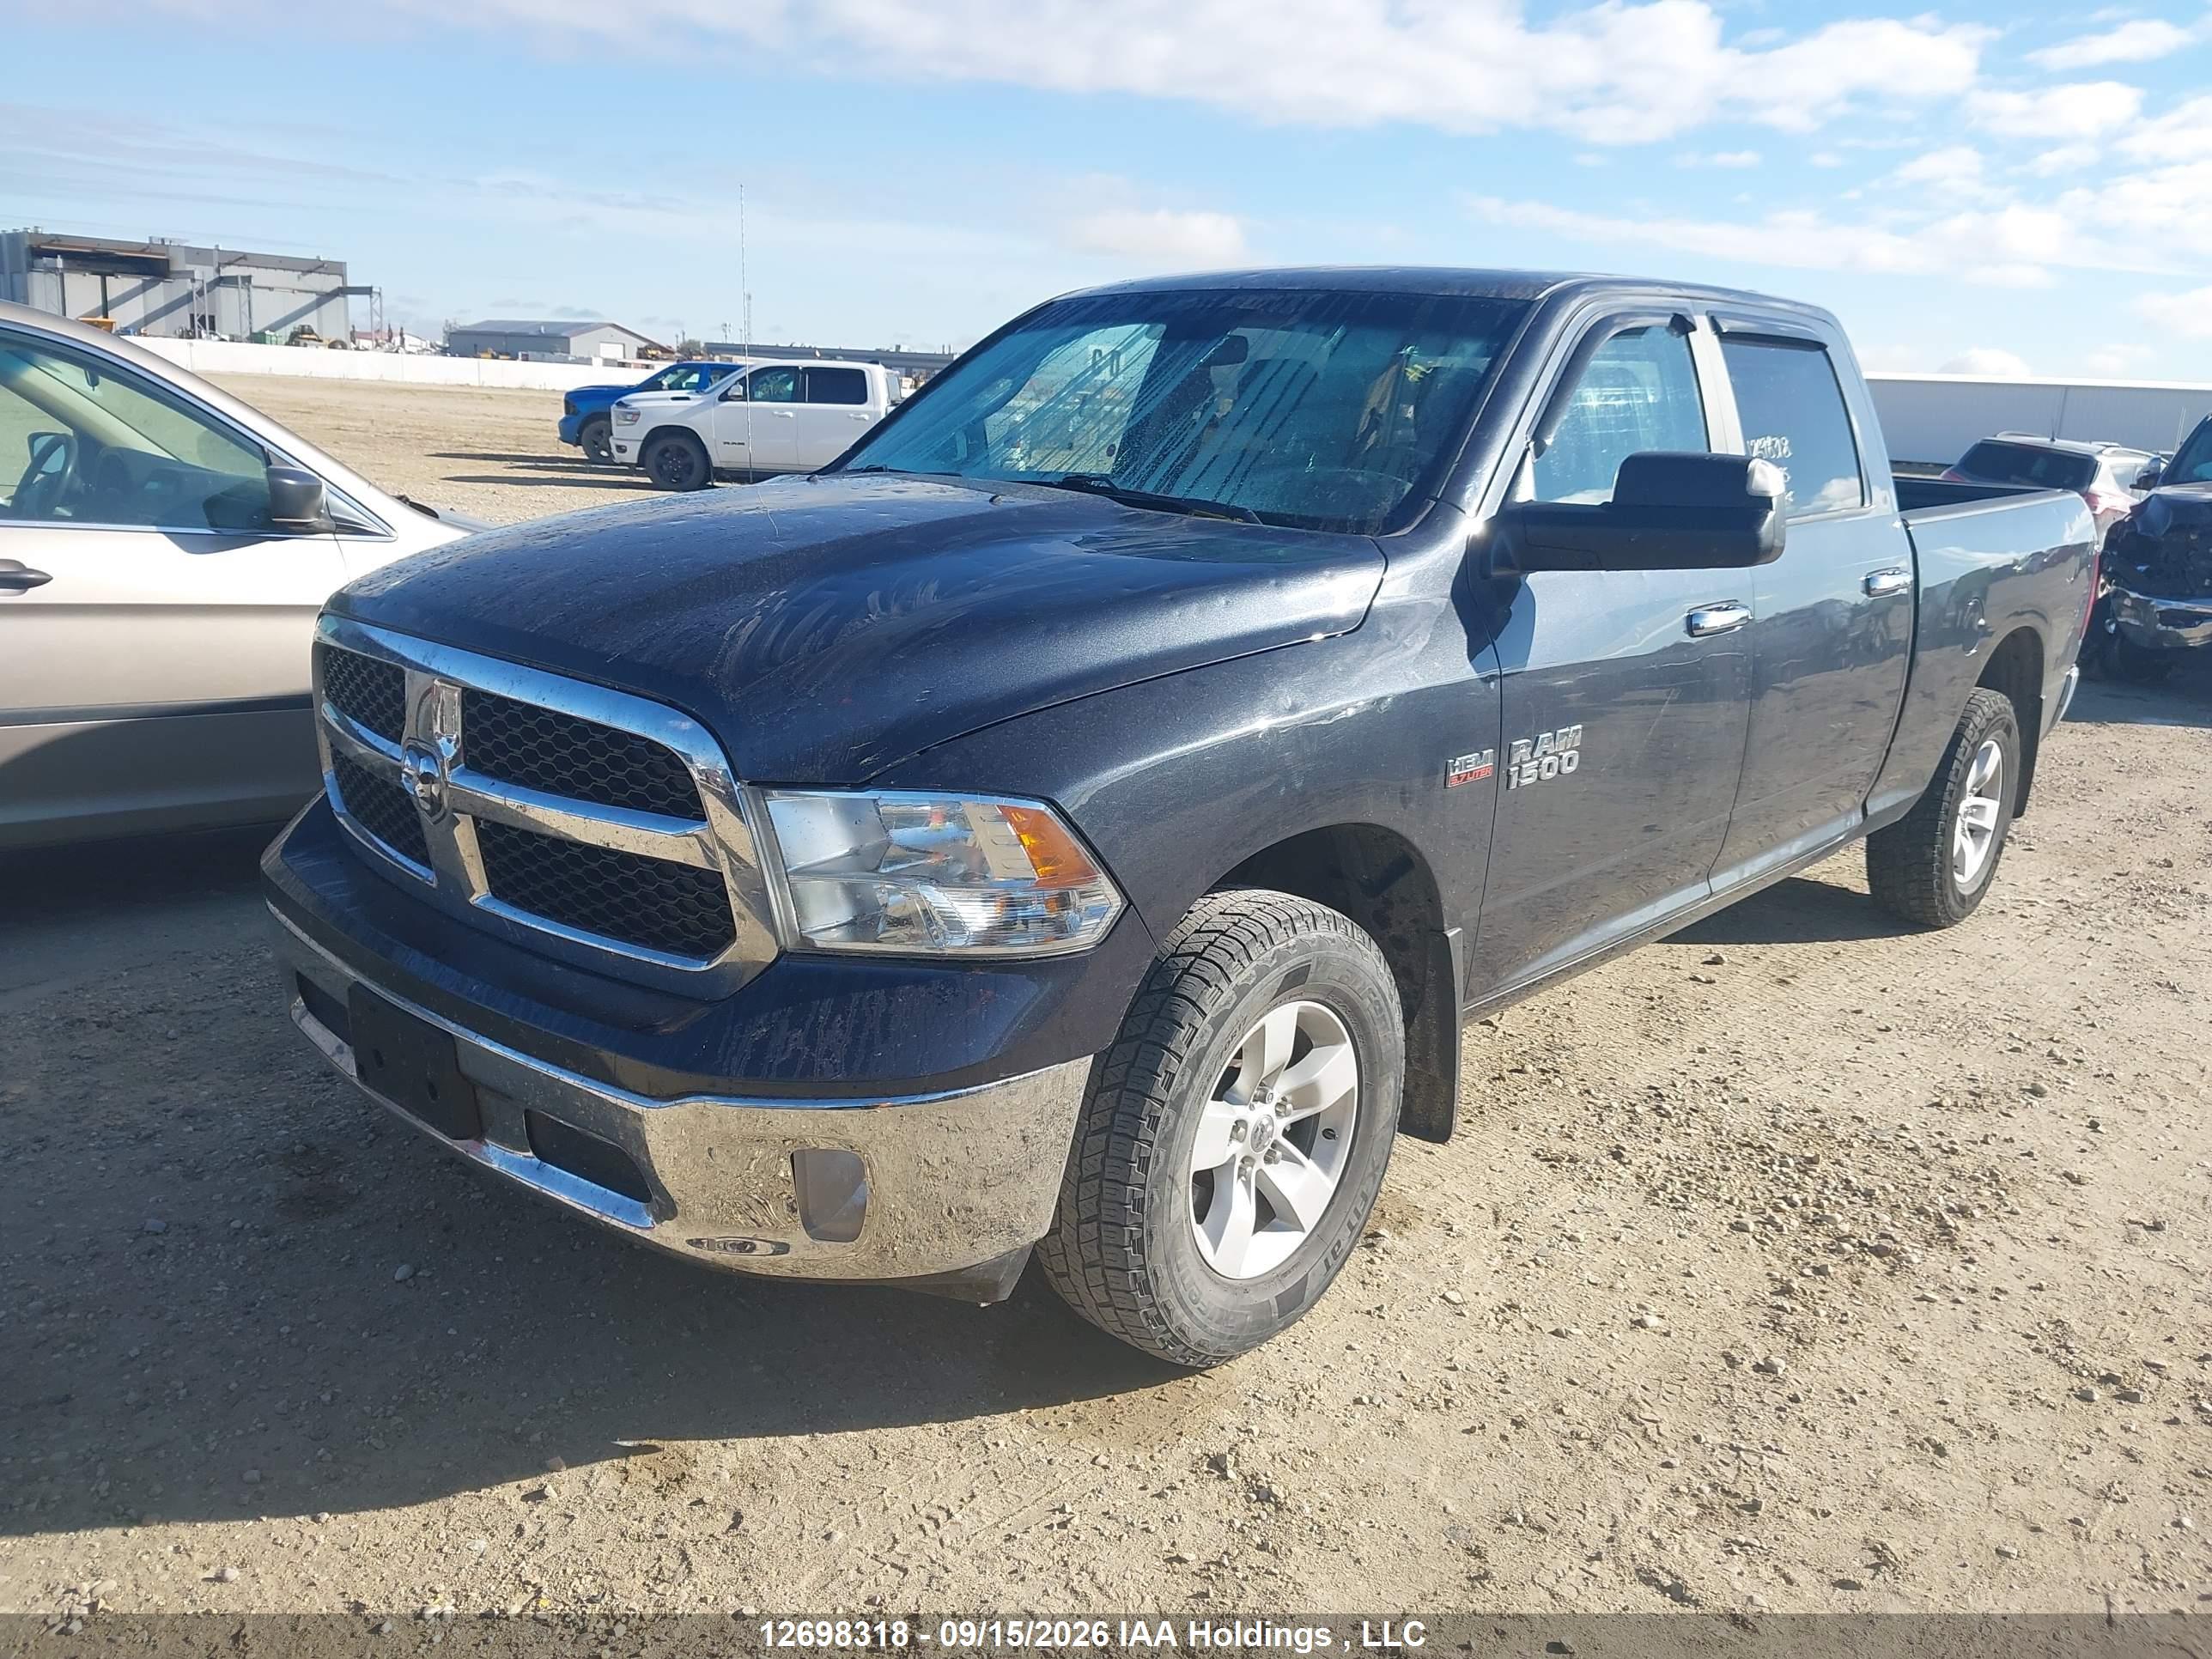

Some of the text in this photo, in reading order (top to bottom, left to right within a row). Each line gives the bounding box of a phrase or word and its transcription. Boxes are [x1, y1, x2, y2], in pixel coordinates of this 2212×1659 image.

[1508, 724, 1583, 764] RAM
[1447, 749, 1494, 774] HEMI
[1465, 766, 1493, 781] LITER
[1506, 750, 1580, 790] 1500
